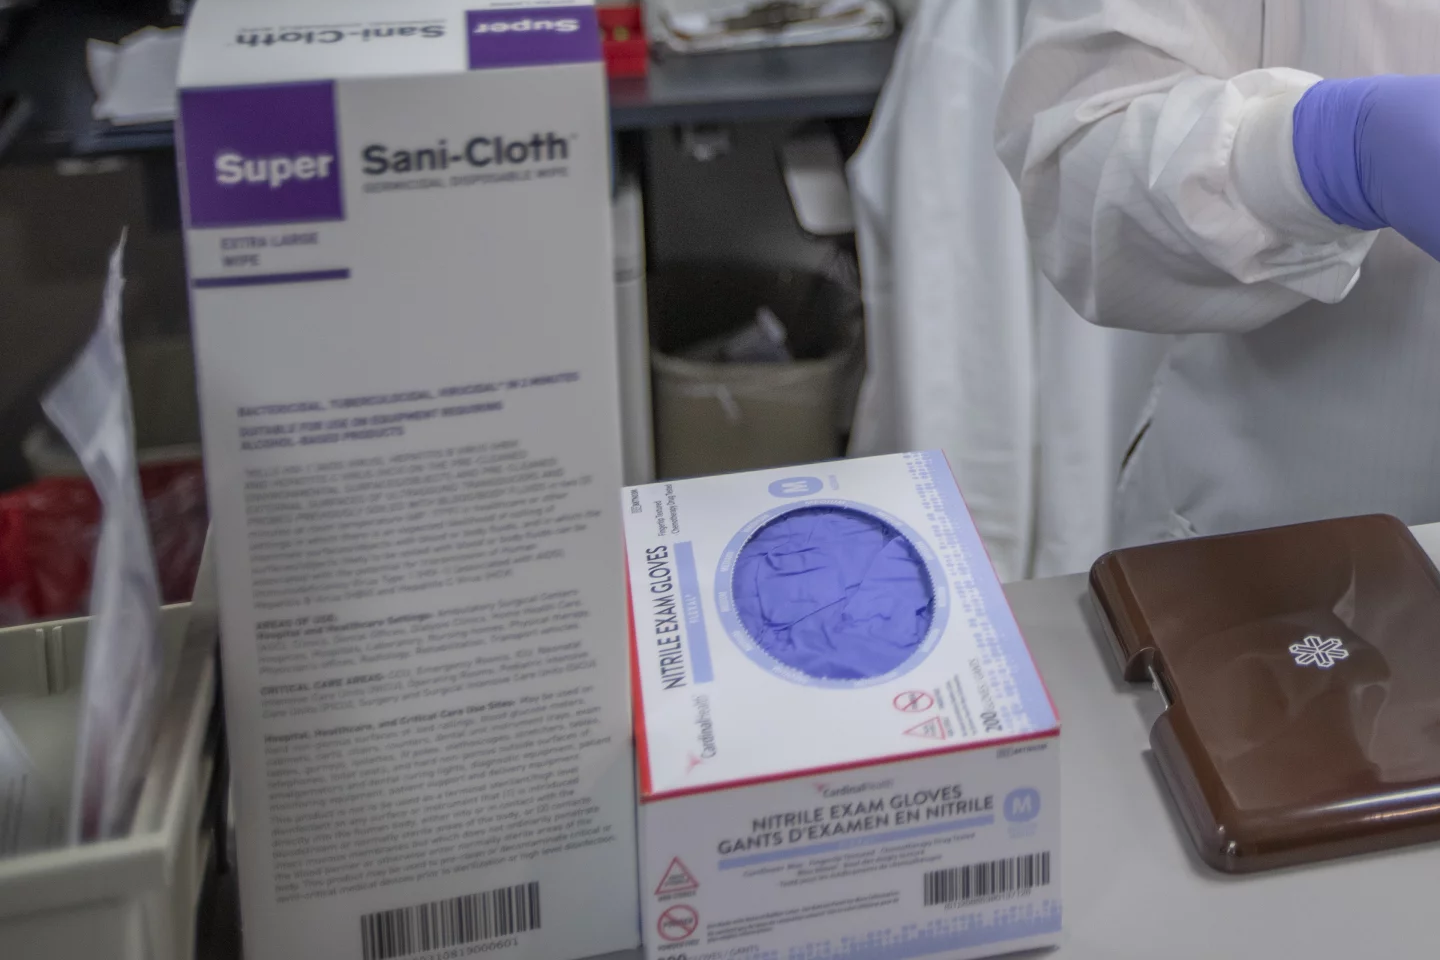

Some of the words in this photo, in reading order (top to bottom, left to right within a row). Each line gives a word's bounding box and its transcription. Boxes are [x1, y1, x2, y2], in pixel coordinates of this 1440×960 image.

[474, 16, 581, 35] Super
[215, 152, 334, 188] Super
[361, 132, 569, 176] Sani-Cloth
[220, 236, 268, 250] EXTRA
[269, 232, 318, 246] LARGE
[223, 253, 260, 267] WIPE
[645, 545, 674, 594] GLOVES
[653, 594, 680, 635] EXAM
[656, 635, 688, 691] NITRILE
[717, 830, 784, 856] GANTS
[788, 814, 889, 843] D'EXAMEN
[895, 808, 920, 826] EN
[926, 794, 995, 818] NITRILE
[752, 807, 825, 834] NITRILE
[829, 798, 885, 820] EXAM
[890, 783, 963, 811] GLOVES
[1012, 794, 1032, 816] M
